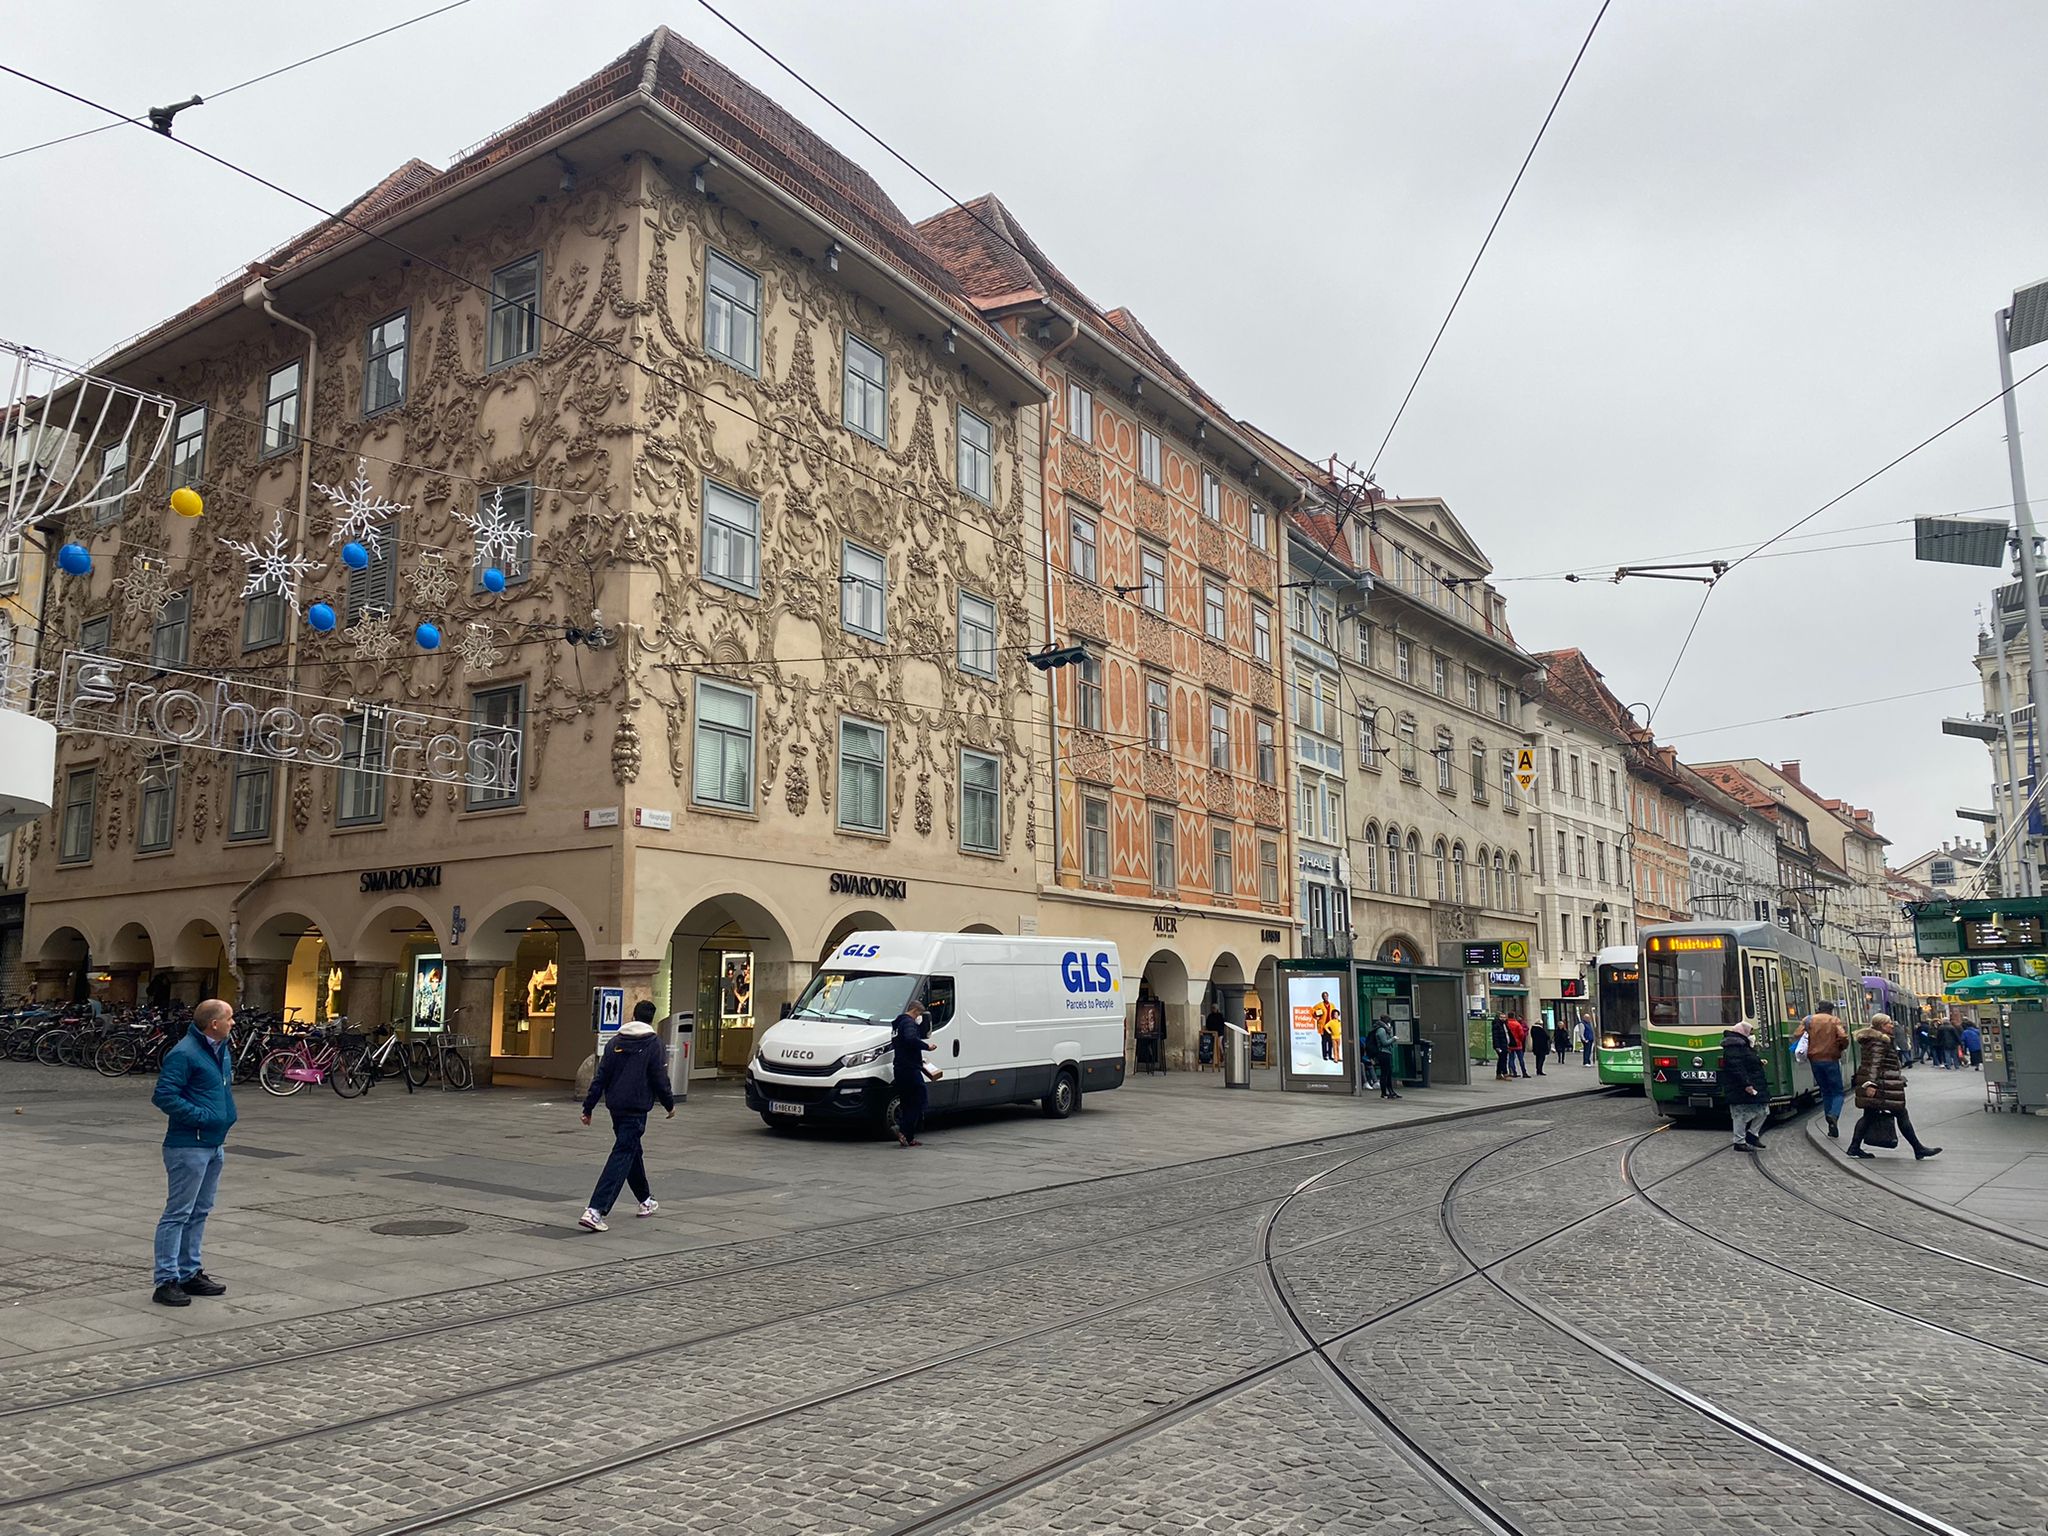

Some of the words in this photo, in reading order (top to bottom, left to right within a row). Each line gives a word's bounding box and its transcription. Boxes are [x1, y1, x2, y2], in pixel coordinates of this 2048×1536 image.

[59, 654, 345, 764] Frohes
[382, 711, 520, 791] Fest
[1519, 752, 1532, 768] A
[1521, 775, 1530, 784] 20
[1307, 856, 1332, 871] HAUS
[359, 865, 442, 893] SWAROVSKI
[830, 872, 907, 899] SWAROVSKI
[1152, 916, 1177, 933] AUER
[1066, 999, 1087, 1010] Parcels
[1088, 1000, 1094, 1009] to
[1095, 998, 1114, 1011] People
[1688, 1039, 1703, 1047] 611
[781, 1049, 814, 1060] IVECO
[1681, 1071, 1716, 1079] GRAZ
